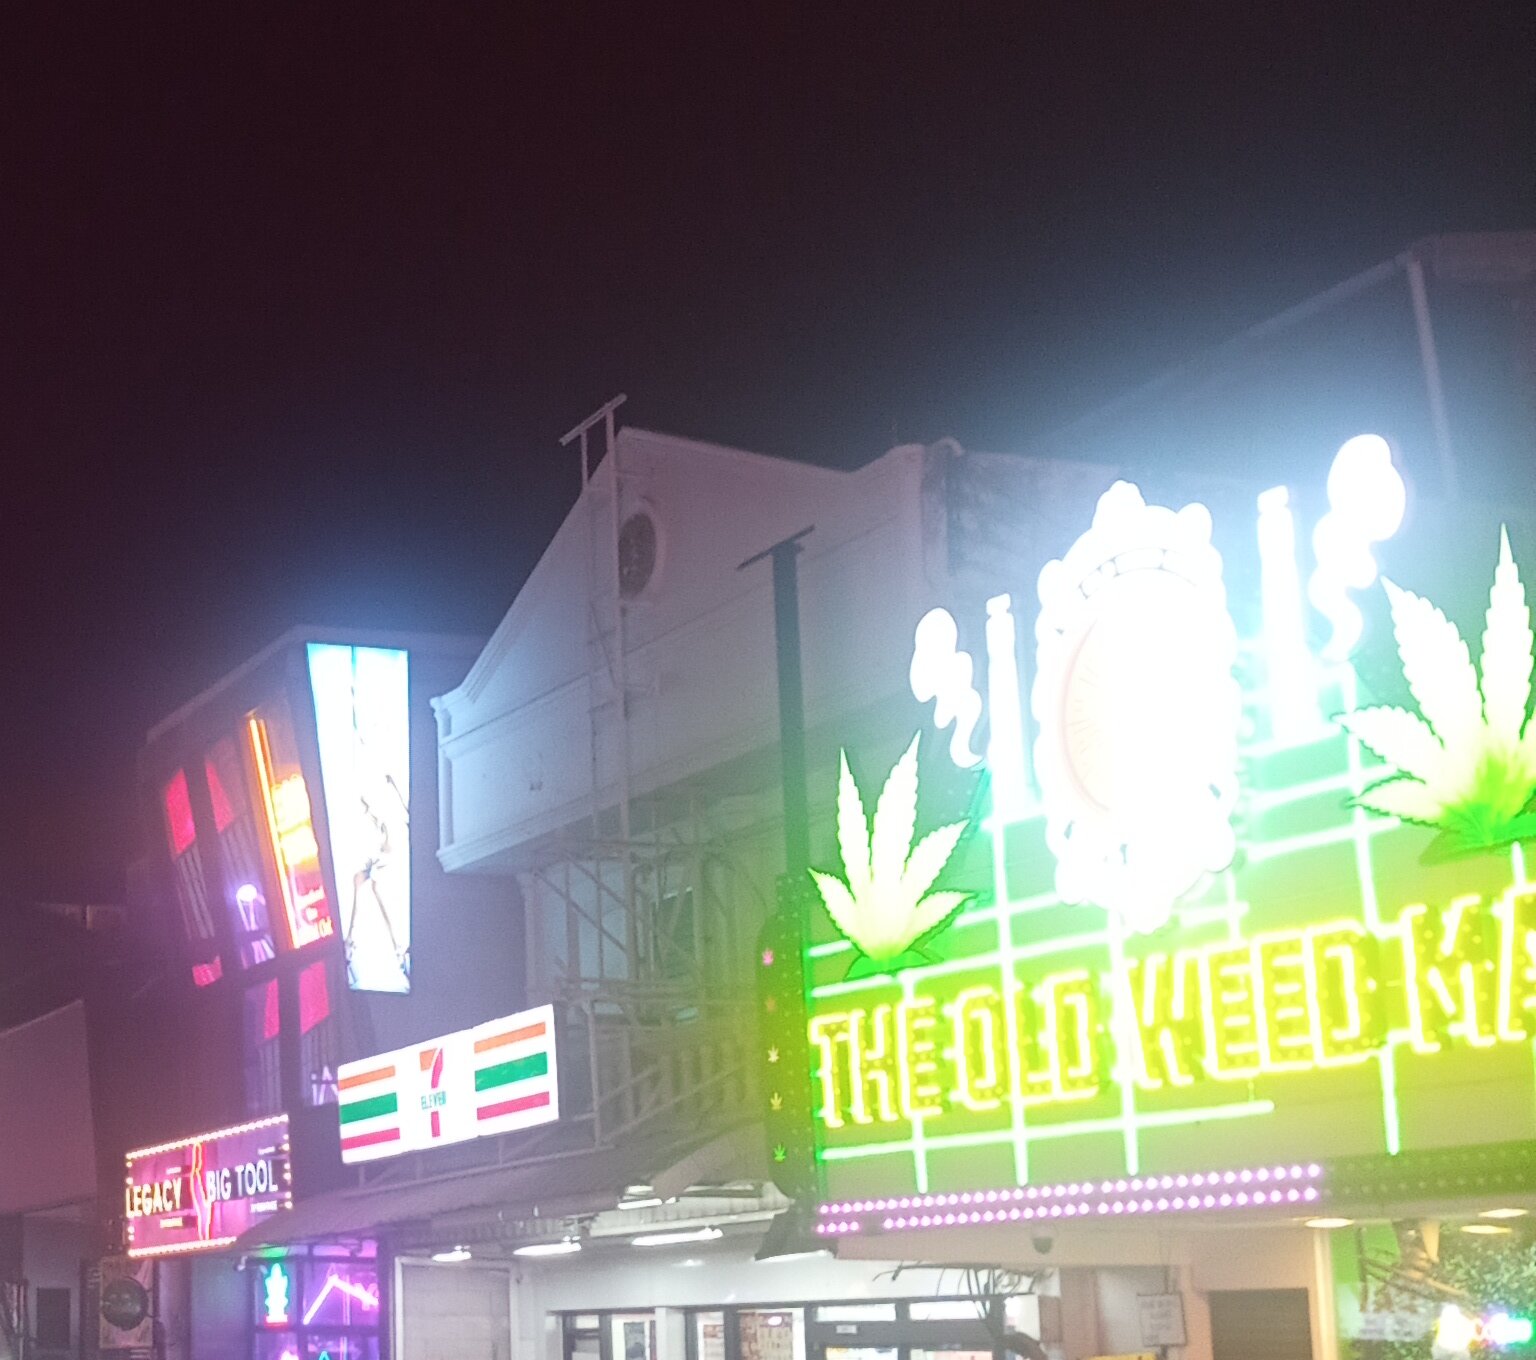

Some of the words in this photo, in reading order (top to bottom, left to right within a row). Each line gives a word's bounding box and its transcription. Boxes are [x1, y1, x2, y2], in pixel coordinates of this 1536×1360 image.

[807, 996, 944, 1128] THE
[952, 970, 1100, 1111] OLD
[1116, 917, 1372, 1088] WEED
[125, 1176, 182, 1219] LEGACY
[205, 1167, 232, 1201] BIG
[235, 1159, 279, 1197] TOOL
